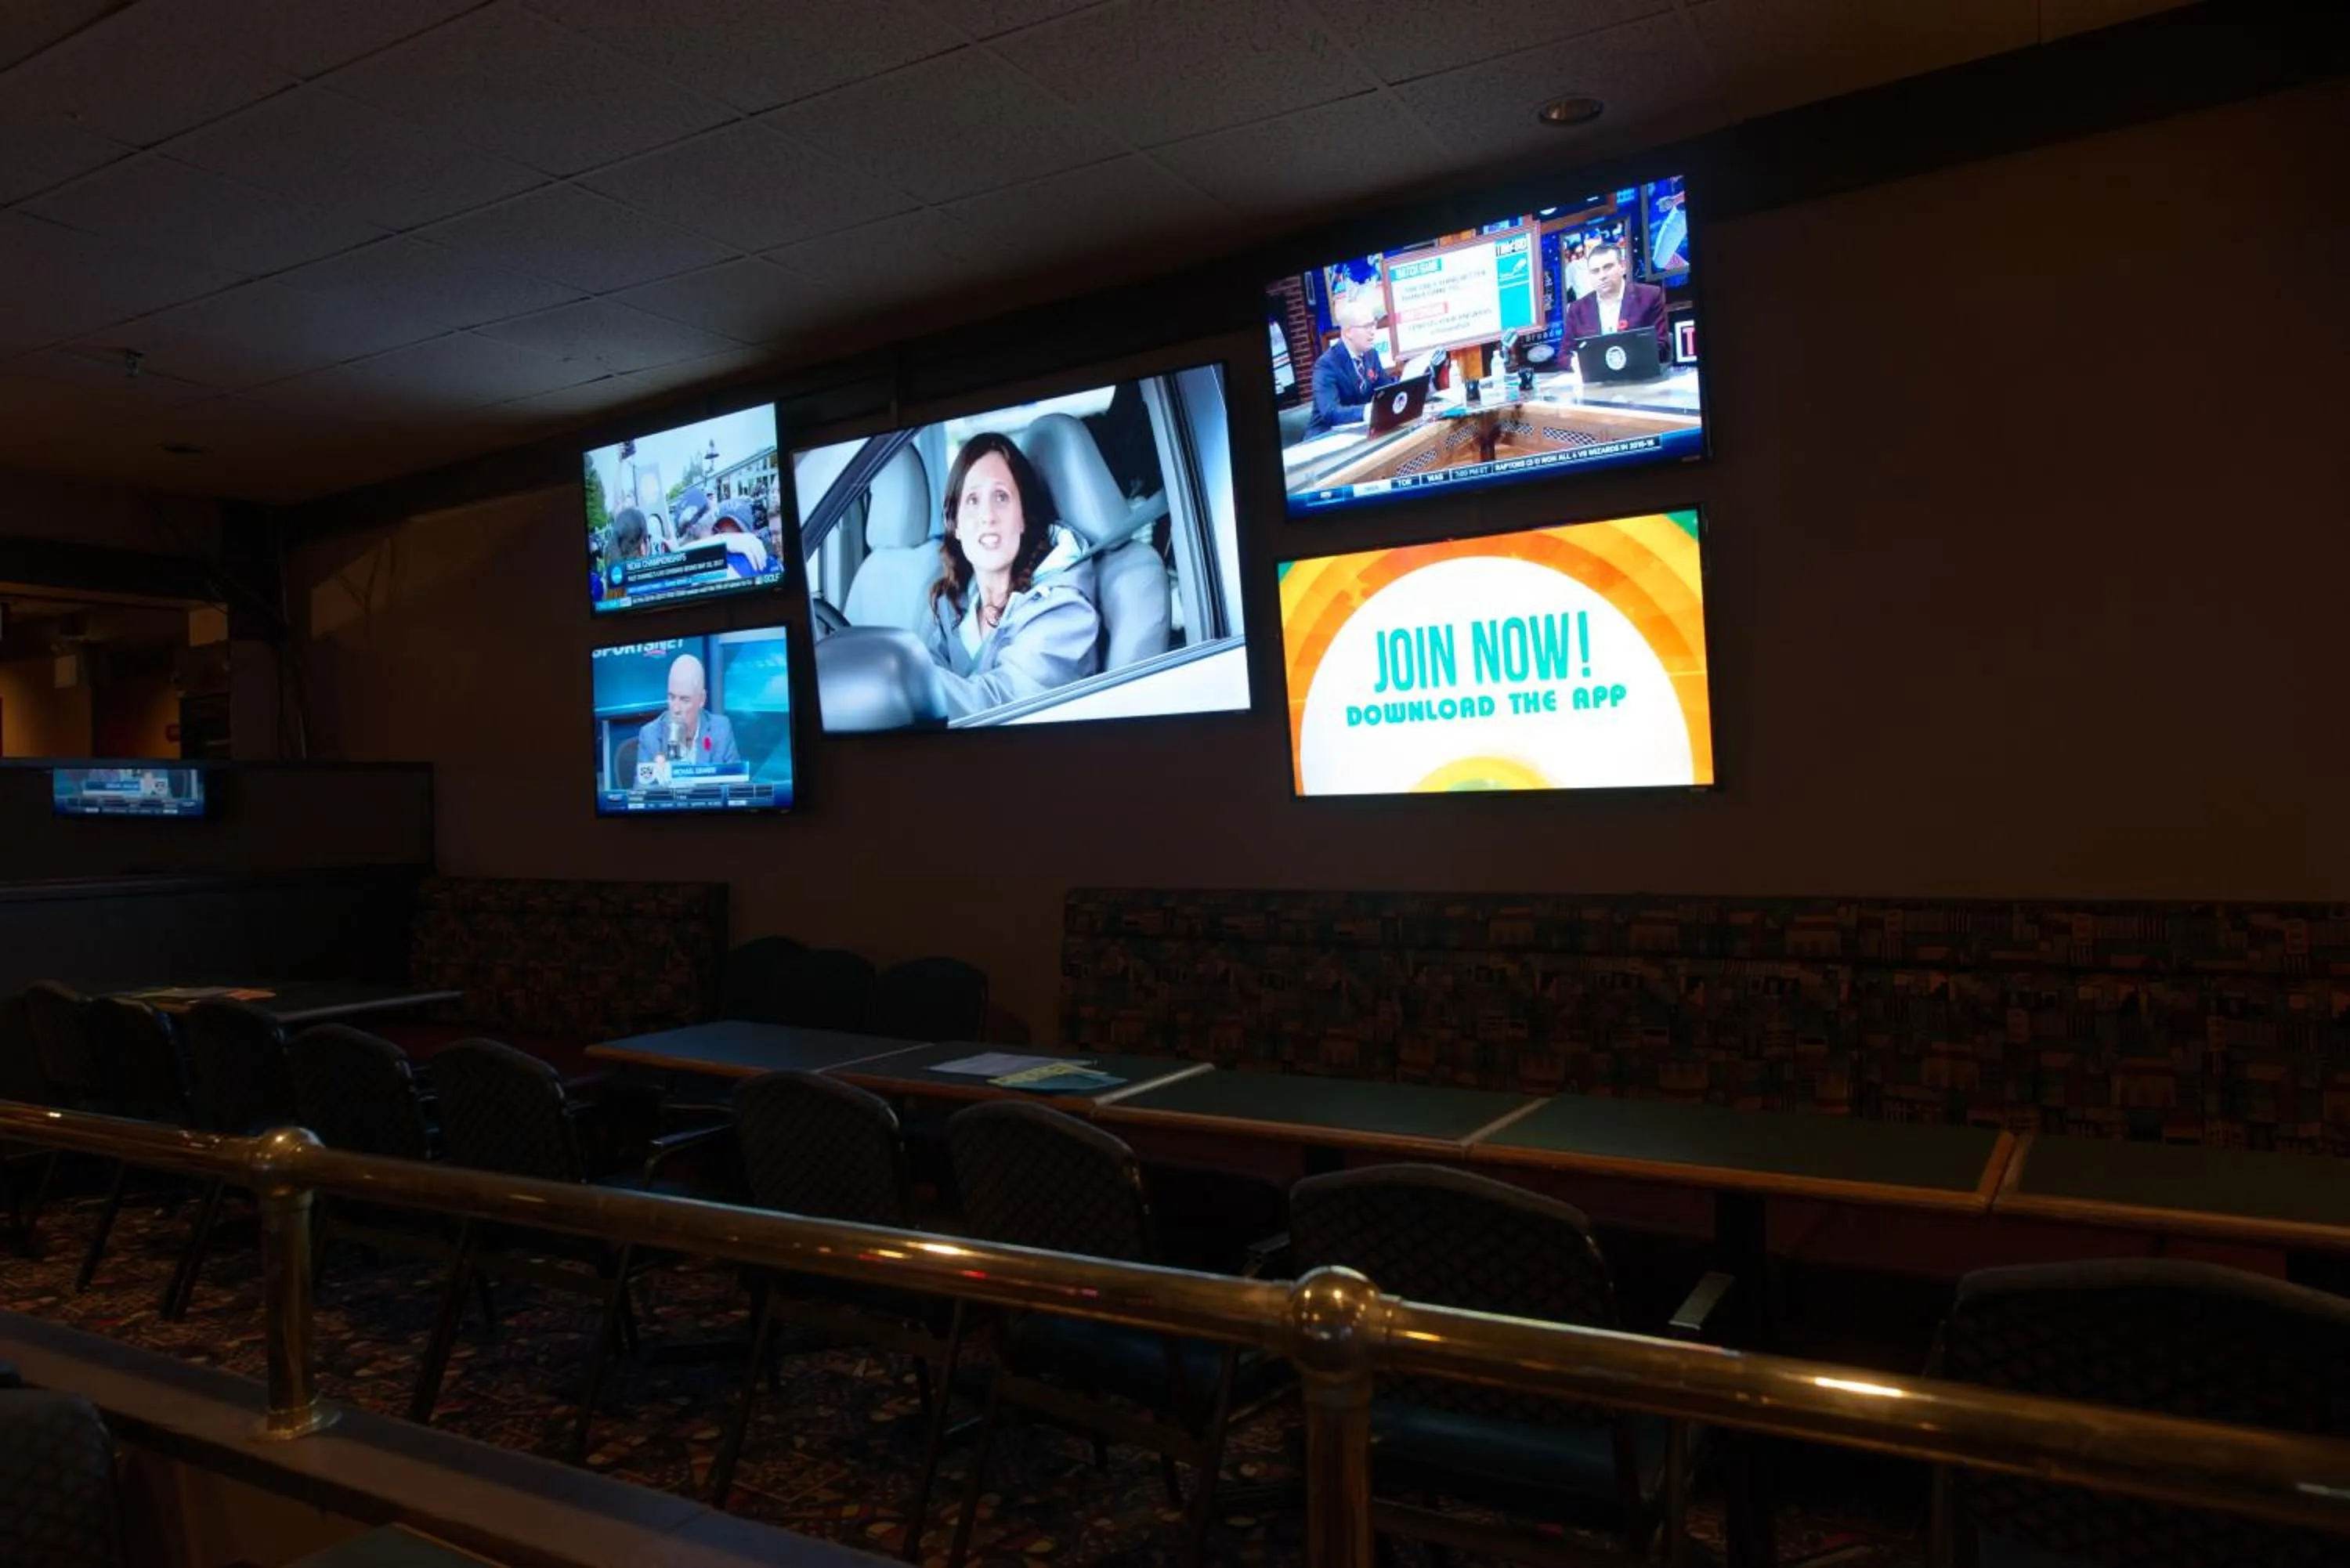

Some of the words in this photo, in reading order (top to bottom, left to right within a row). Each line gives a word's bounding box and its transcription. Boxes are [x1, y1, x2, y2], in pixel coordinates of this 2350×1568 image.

[1495, 460, 1525, 471] RAPTORS
[1559, 453, 1571, 461] ALL
[1588, 444, 1619, 456] WIZARDS
[1374, 624, 1457, 693] JOIN
[1471, 610, 1591, 685] NOW!
[1345, 695, 1495, 727] DOWNLOAD
[1507, 690, 1557, 714] THE
[1572, 684, 1628, 710] APP
